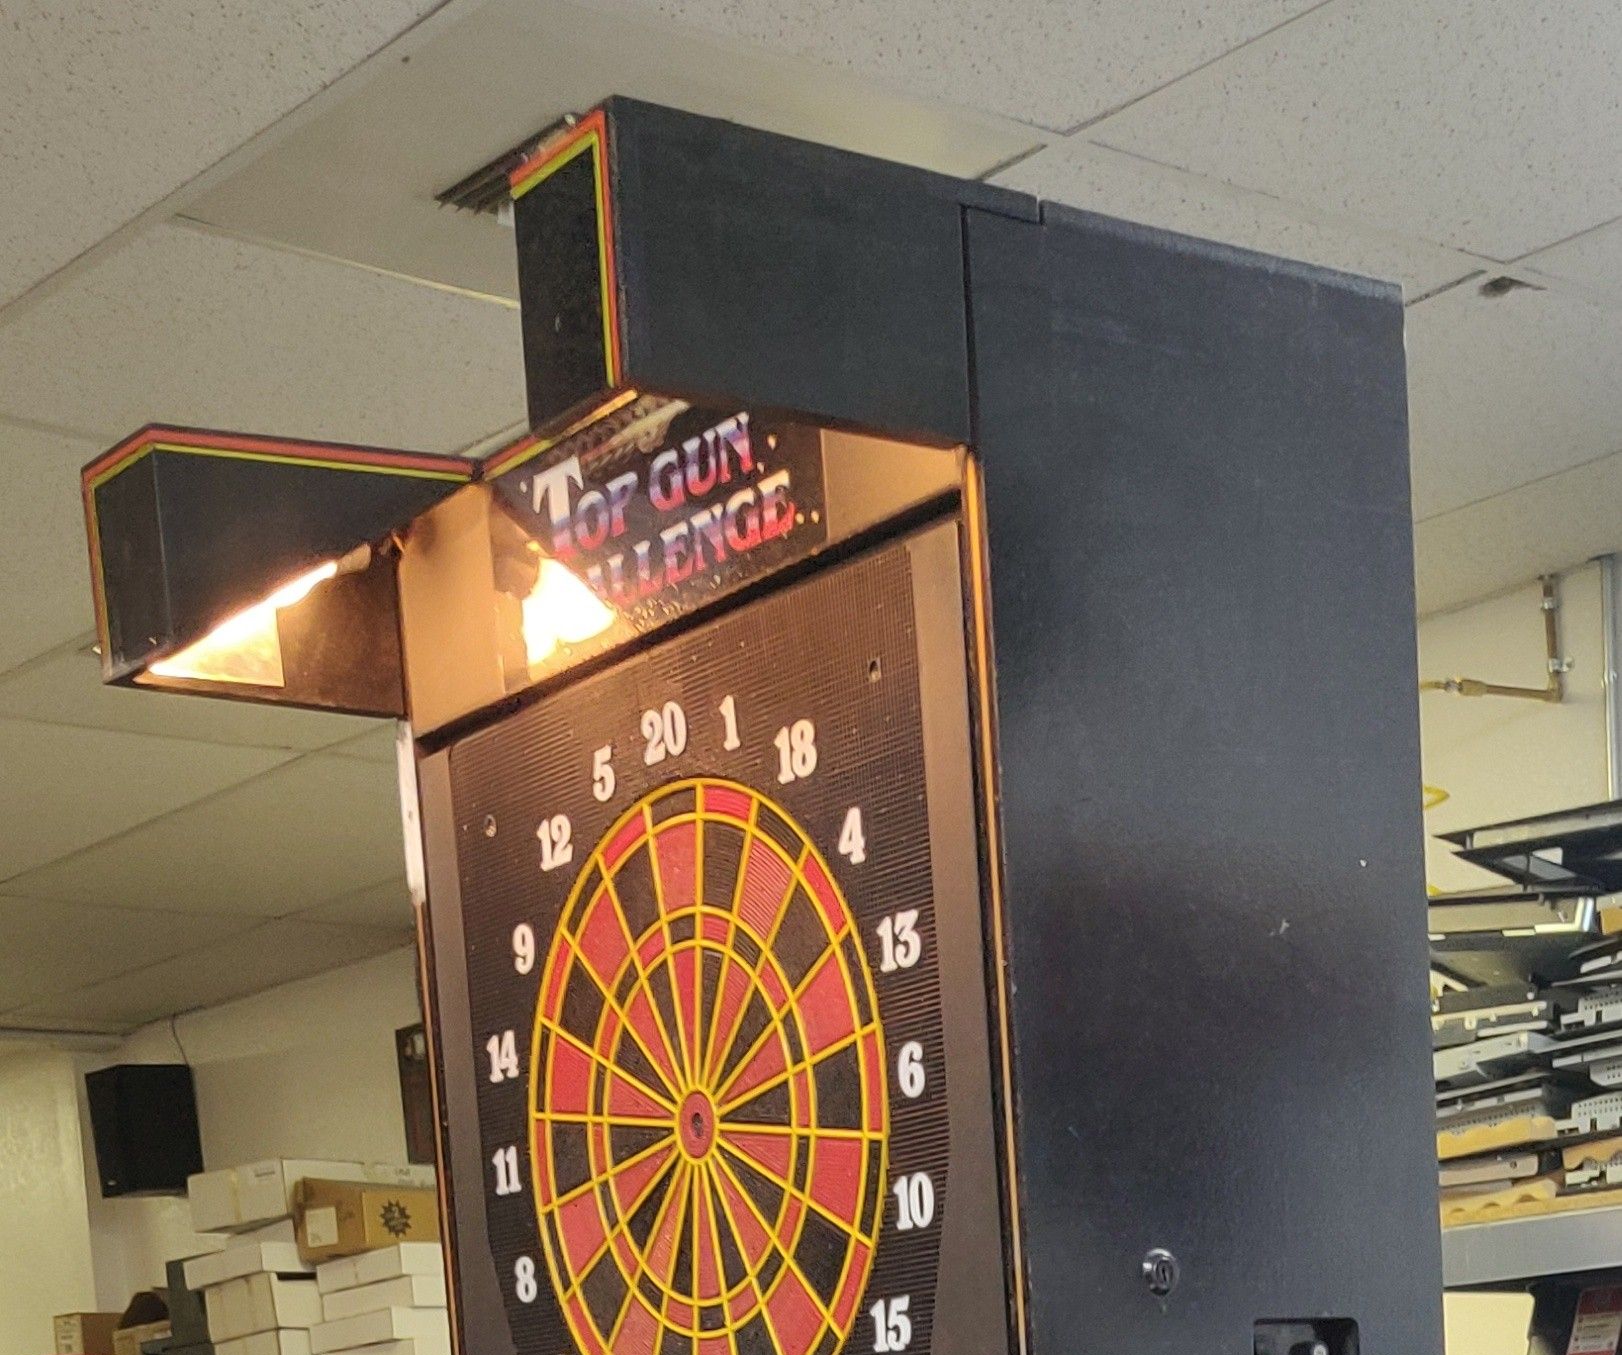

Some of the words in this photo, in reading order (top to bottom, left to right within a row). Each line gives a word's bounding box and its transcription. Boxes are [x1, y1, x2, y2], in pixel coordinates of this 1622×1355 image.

[532, 455, 639, 562] TOP
[650, 411, 753, 512] GUN
[641, 701, 687, 766] 20
[719, 695, 741, 751] 1
[593, 744, 616, 802] 5
[774, 720, 817, 785] 18
[536, 814, 573, 872] 12
[837, 807, 866, 865] 4
[512, 922, 536, 975] 9
[876, 908, 922, 973] 13
[486, 1030, 519, 1083] 14
[897, 1040, 926, 1098] 6
[492, 1145, 522, 1196] 11
[892, 1171, 935, 1231] 10
[514, 1256, 538, 1303] 8
[869, 1294, 912, 1353] 15
